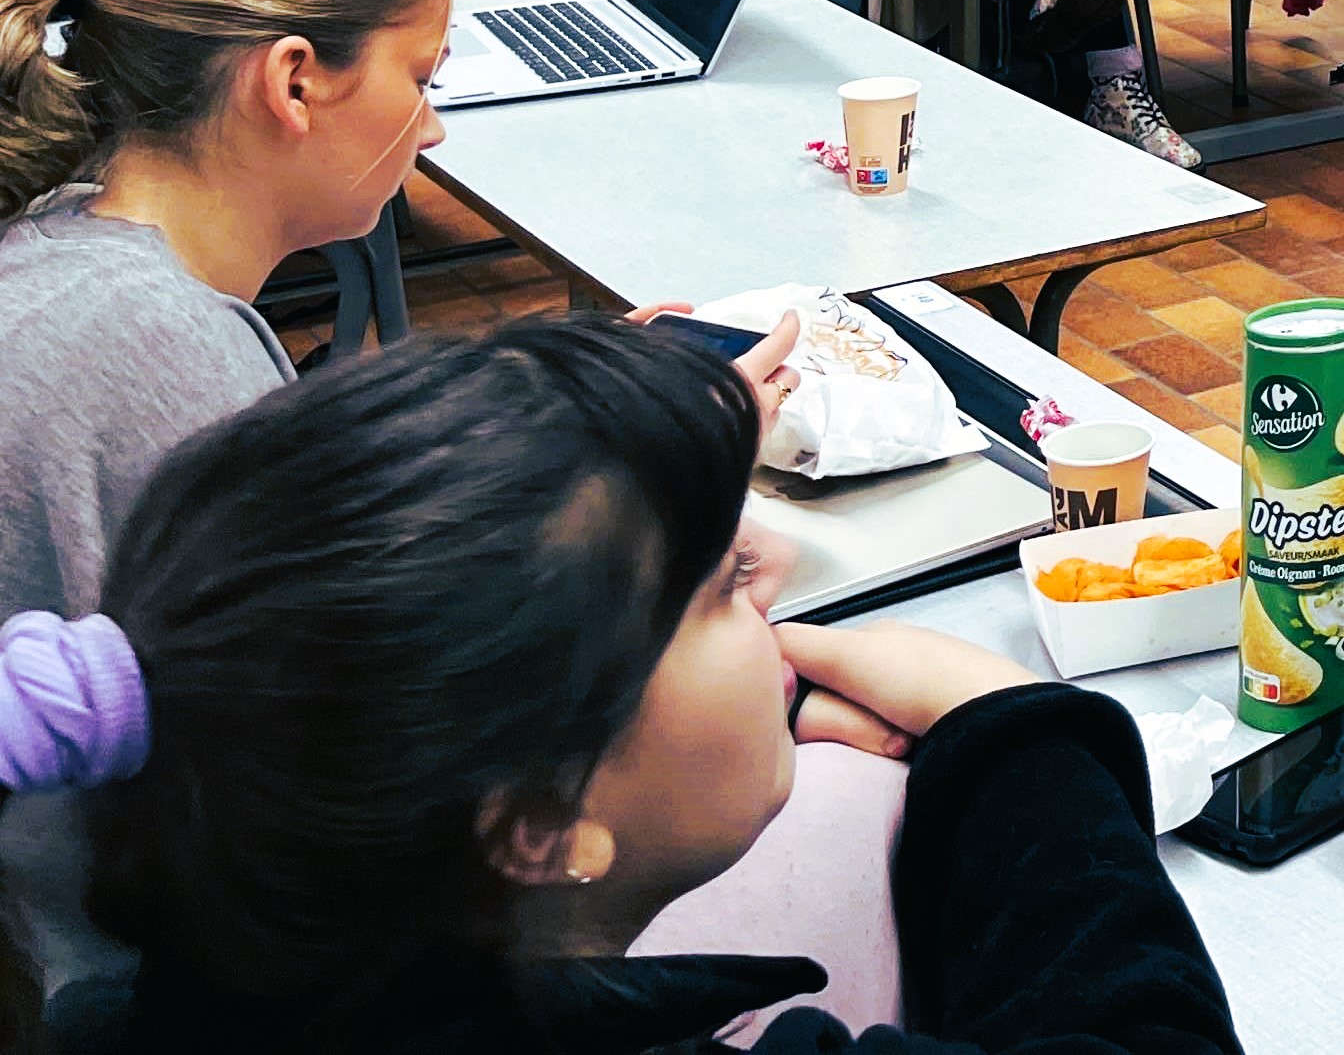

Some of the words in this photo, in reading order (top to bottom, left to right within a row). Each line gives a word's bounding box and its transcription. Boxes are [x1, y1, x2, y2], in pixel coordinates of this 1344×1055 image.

[1251, 411, 1325, 435] Sensation
[1269, 547, 1340, 562] SAVEUR/SMAAK
[1249, 560, 1276, 576] Crème
[1277, 566, 1316, 583] Oignon
